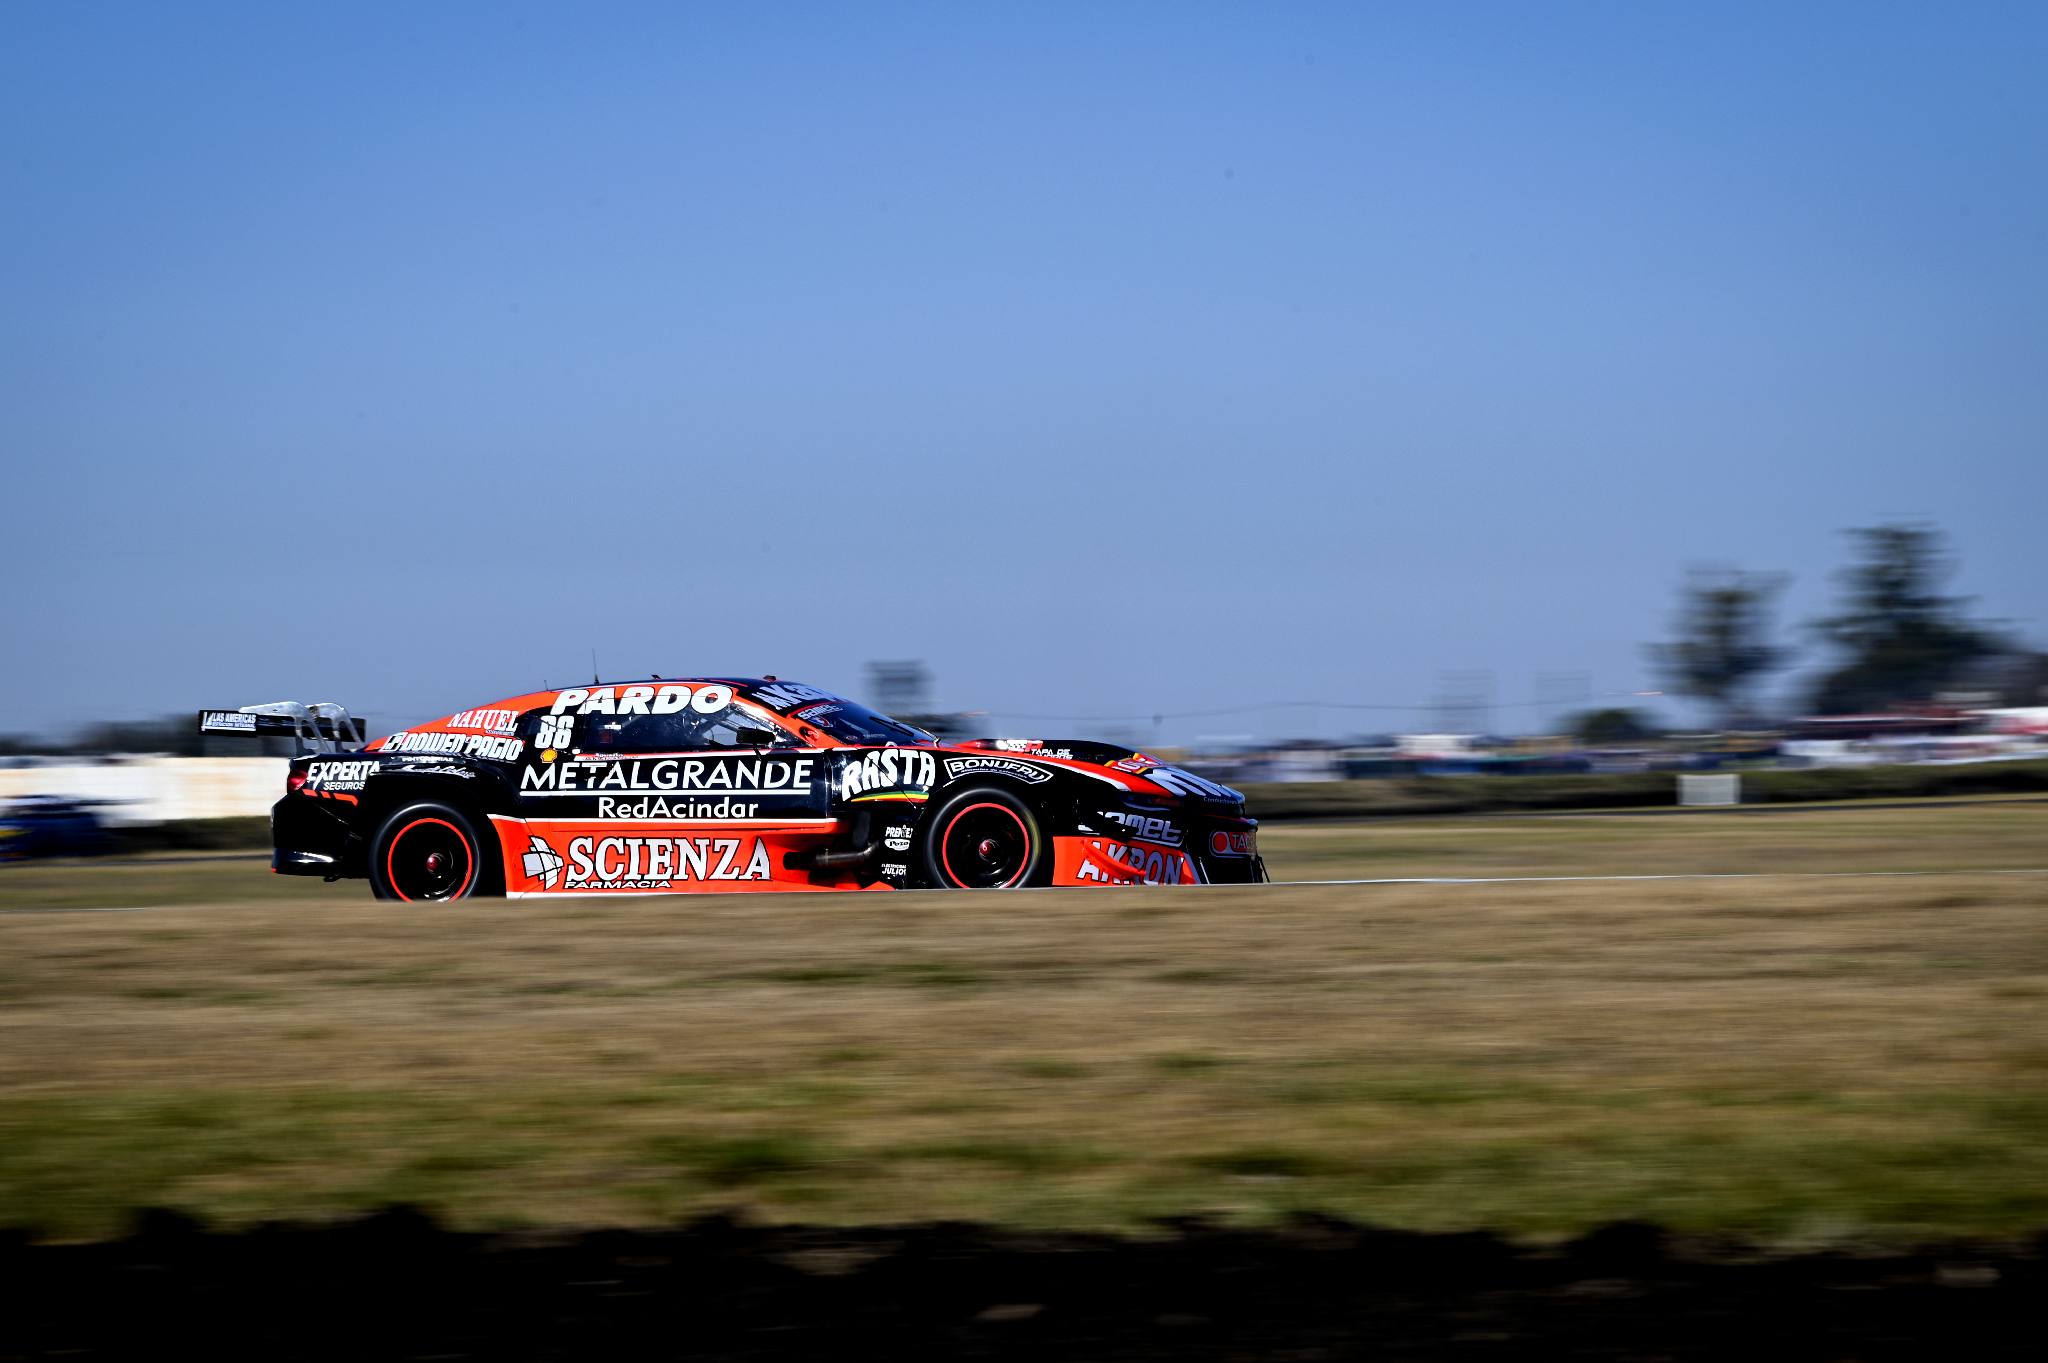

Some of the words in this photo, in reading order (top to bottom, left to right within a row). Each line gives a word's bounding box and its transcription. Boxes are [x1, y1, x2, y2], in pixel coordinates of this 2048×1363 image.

[550, 685, 733, 715] PARDO
[447, 710, 519, 732] NAHUEL
[307, 761, 380, 790] EXPERTA
[520, 760, 814, 790] METALGRANDE
[842, 749, 936, 801] RASTA
[950, 760, 1045, 780] BONUFRU
[323, 782, 366, 791] SEGUROS
[598, 797, 759, 819] RedAcindar
[567, 836, 772, 882] SCIENZA
[564, 880, 673, 889] FARMACIA
